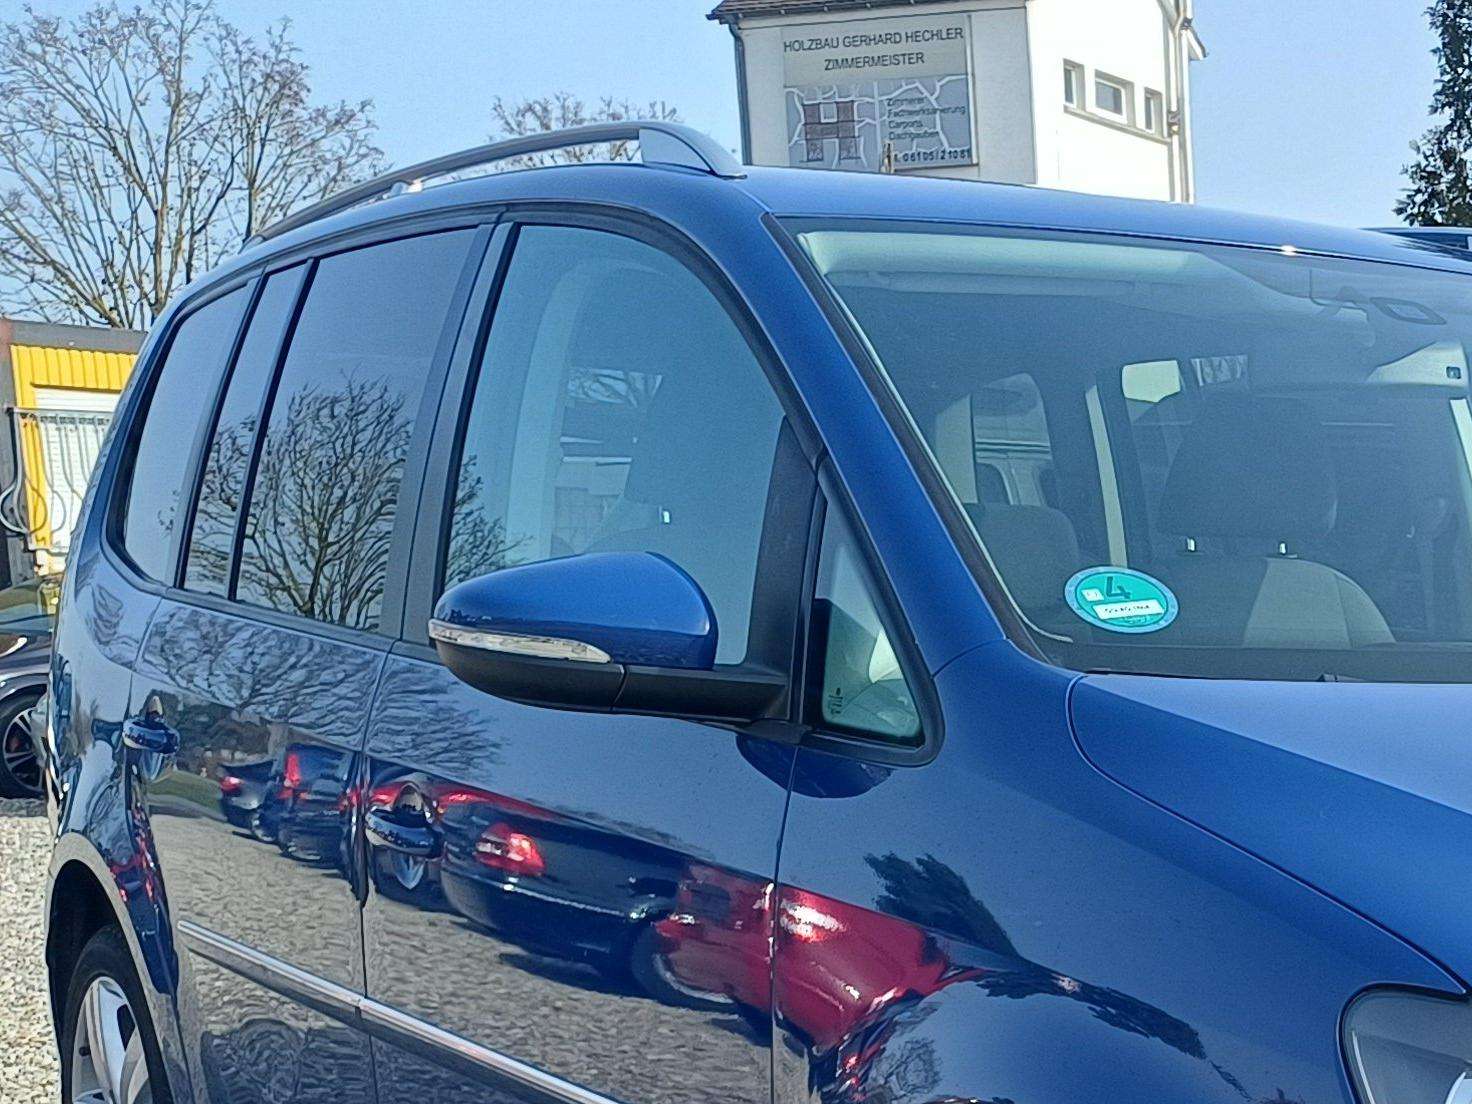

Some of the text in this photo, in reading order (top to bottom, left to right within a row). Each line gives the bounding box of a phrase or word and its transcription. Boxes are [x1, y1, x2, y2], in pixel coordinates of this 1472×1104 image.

[783, 27, 964, 53] HOLZBAU GERHARD HECHLER
[824, 52, 925, 71] ZIMMERMEISTER
[1106, 577, 1132, 599] 4
